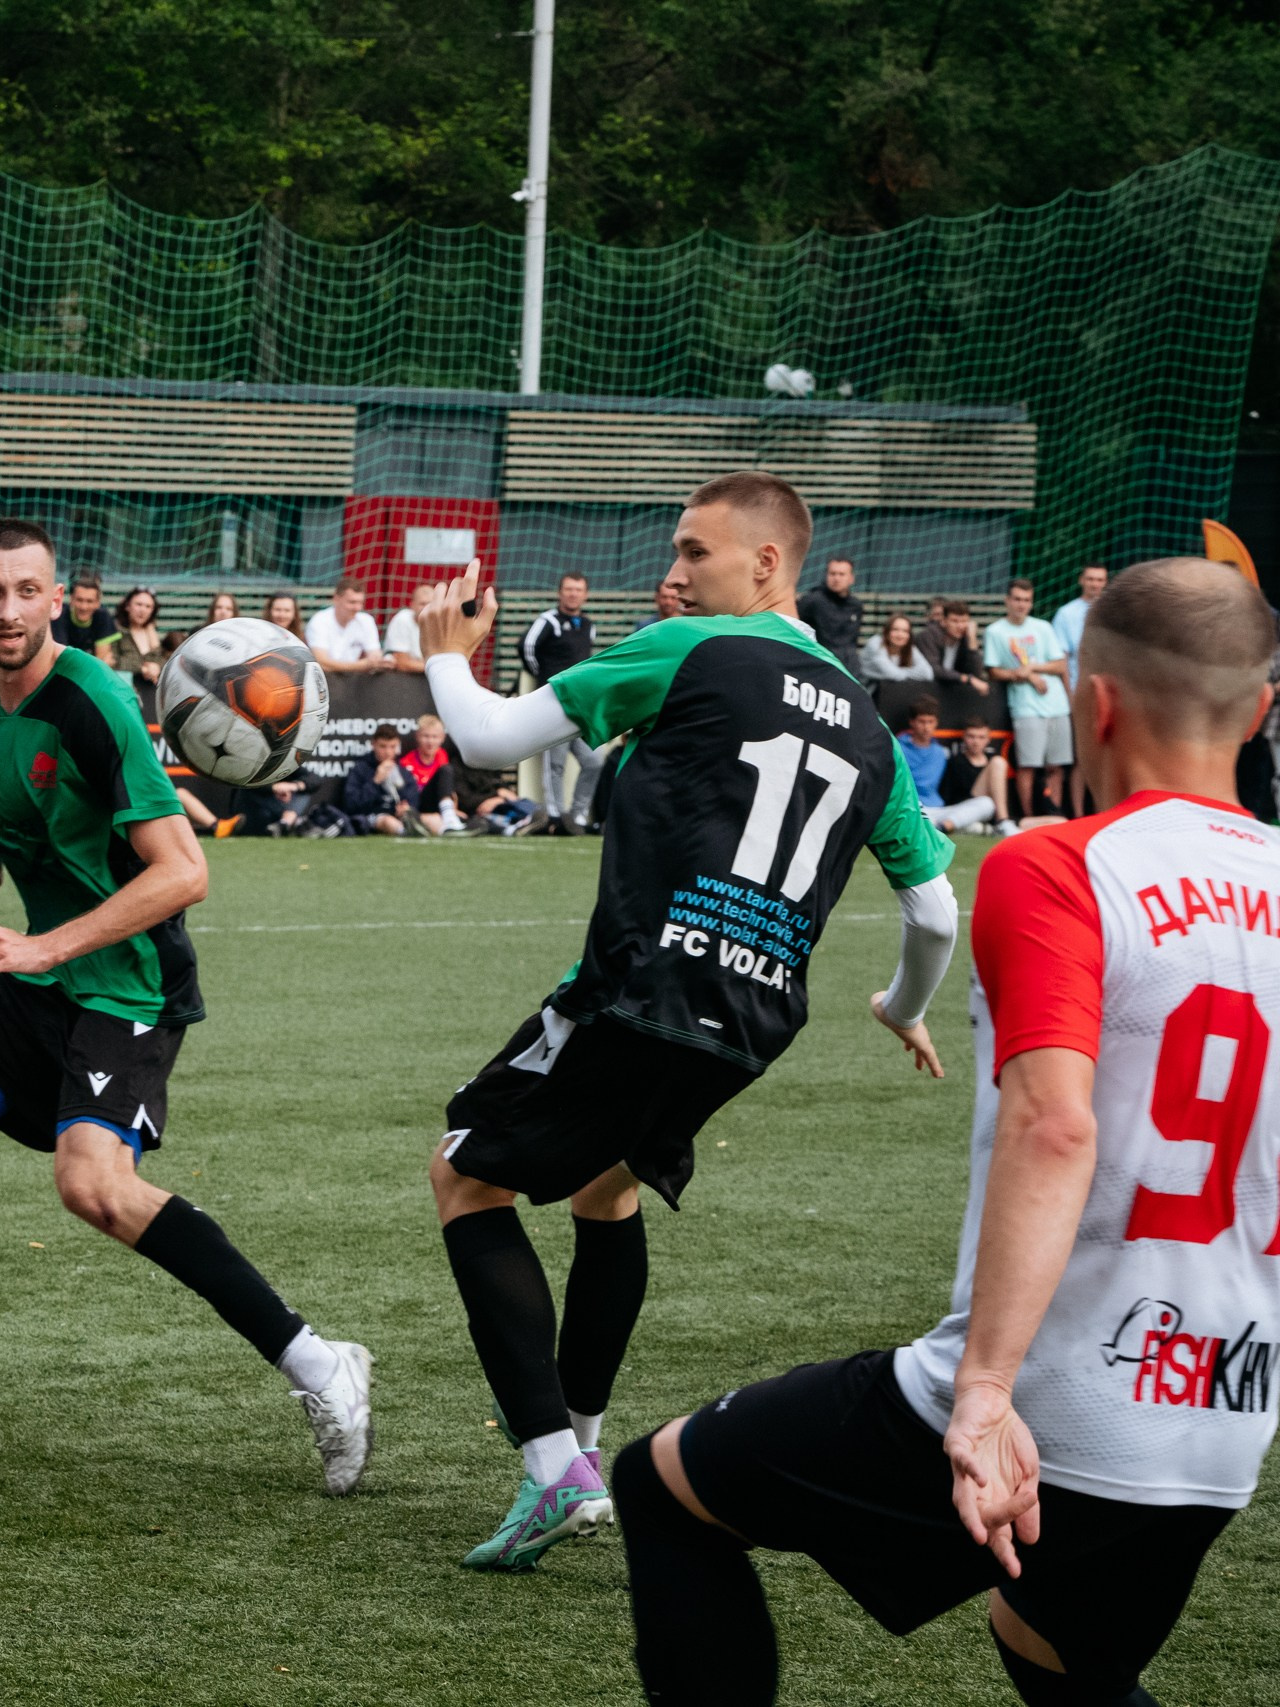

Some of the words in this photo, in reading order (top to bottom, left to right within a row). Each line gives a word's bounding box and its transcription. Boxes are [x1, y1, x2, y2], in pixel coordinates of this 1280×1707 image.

[782, 674, 851, 729] БОДЯ
[730, 732, 860, 903] 17
[659, 923, 710, 957] FC
[1136, 877, 1280, 947] ДАНИ
[1124, 983, 1280, 1256] 9
